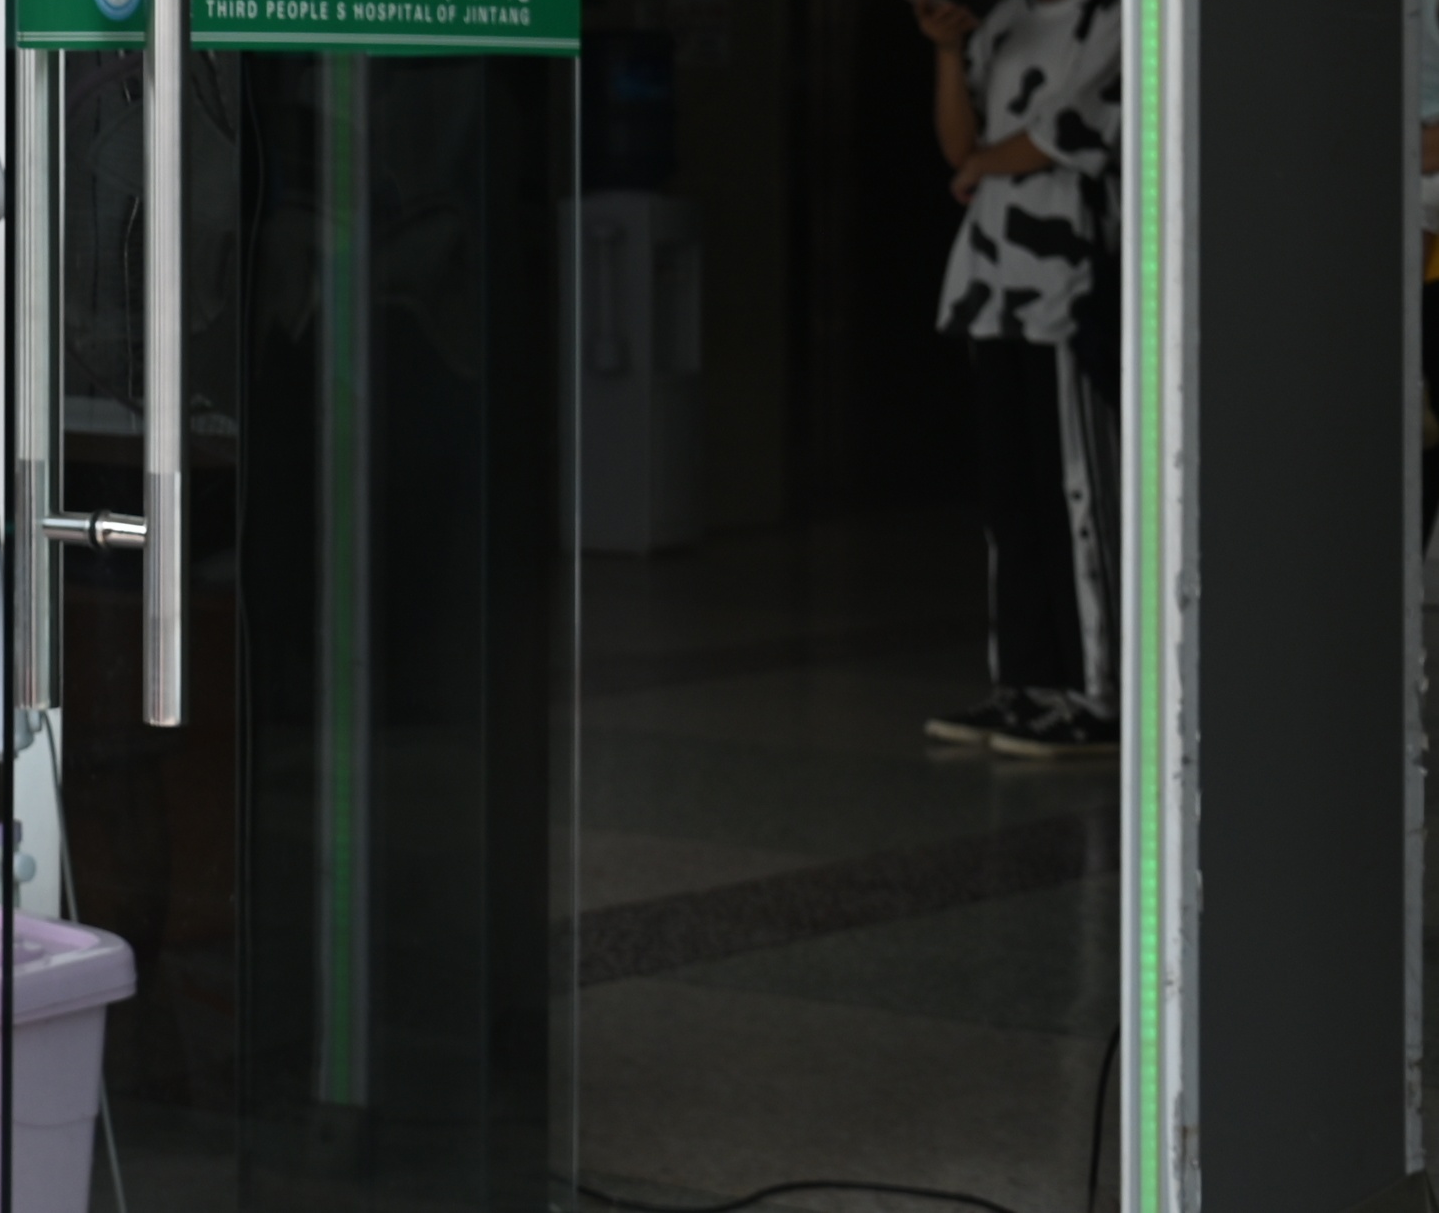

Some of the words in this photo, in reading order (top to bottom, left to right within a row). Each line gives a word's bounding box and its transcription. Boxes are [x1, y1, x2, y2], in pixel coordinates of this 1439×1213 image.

[206, 0, 259, 19] THIRD
[436, 4, 456, 23] OF
[463, 5, 531, 26] JINTANG
